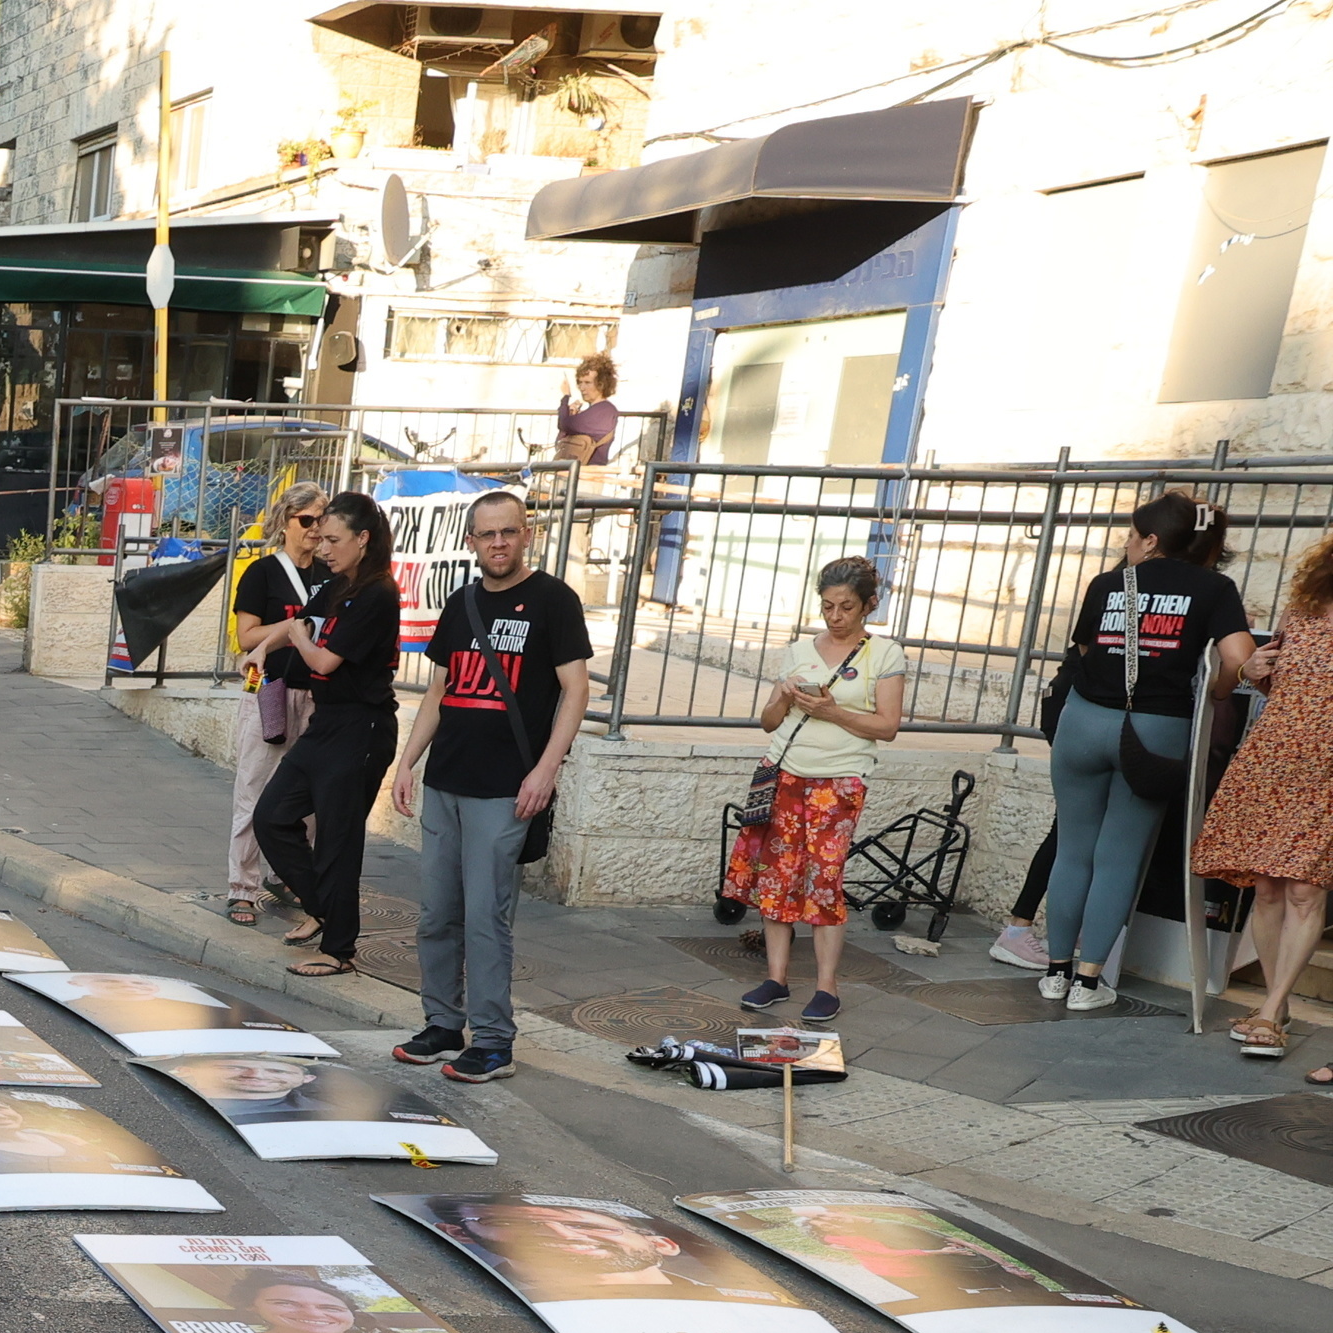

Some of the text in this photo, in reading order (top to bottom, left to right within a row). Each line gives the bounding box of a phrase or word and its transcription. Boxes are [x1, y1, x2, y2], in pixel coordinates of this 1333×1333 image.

[1151, 594, 1192, 615] THEM
[492, 619, 530, 636] מחזירים
[1140, 613, 1185, 636] NOW!
[177, 1244, 267, 1254] CARMEL GAT
